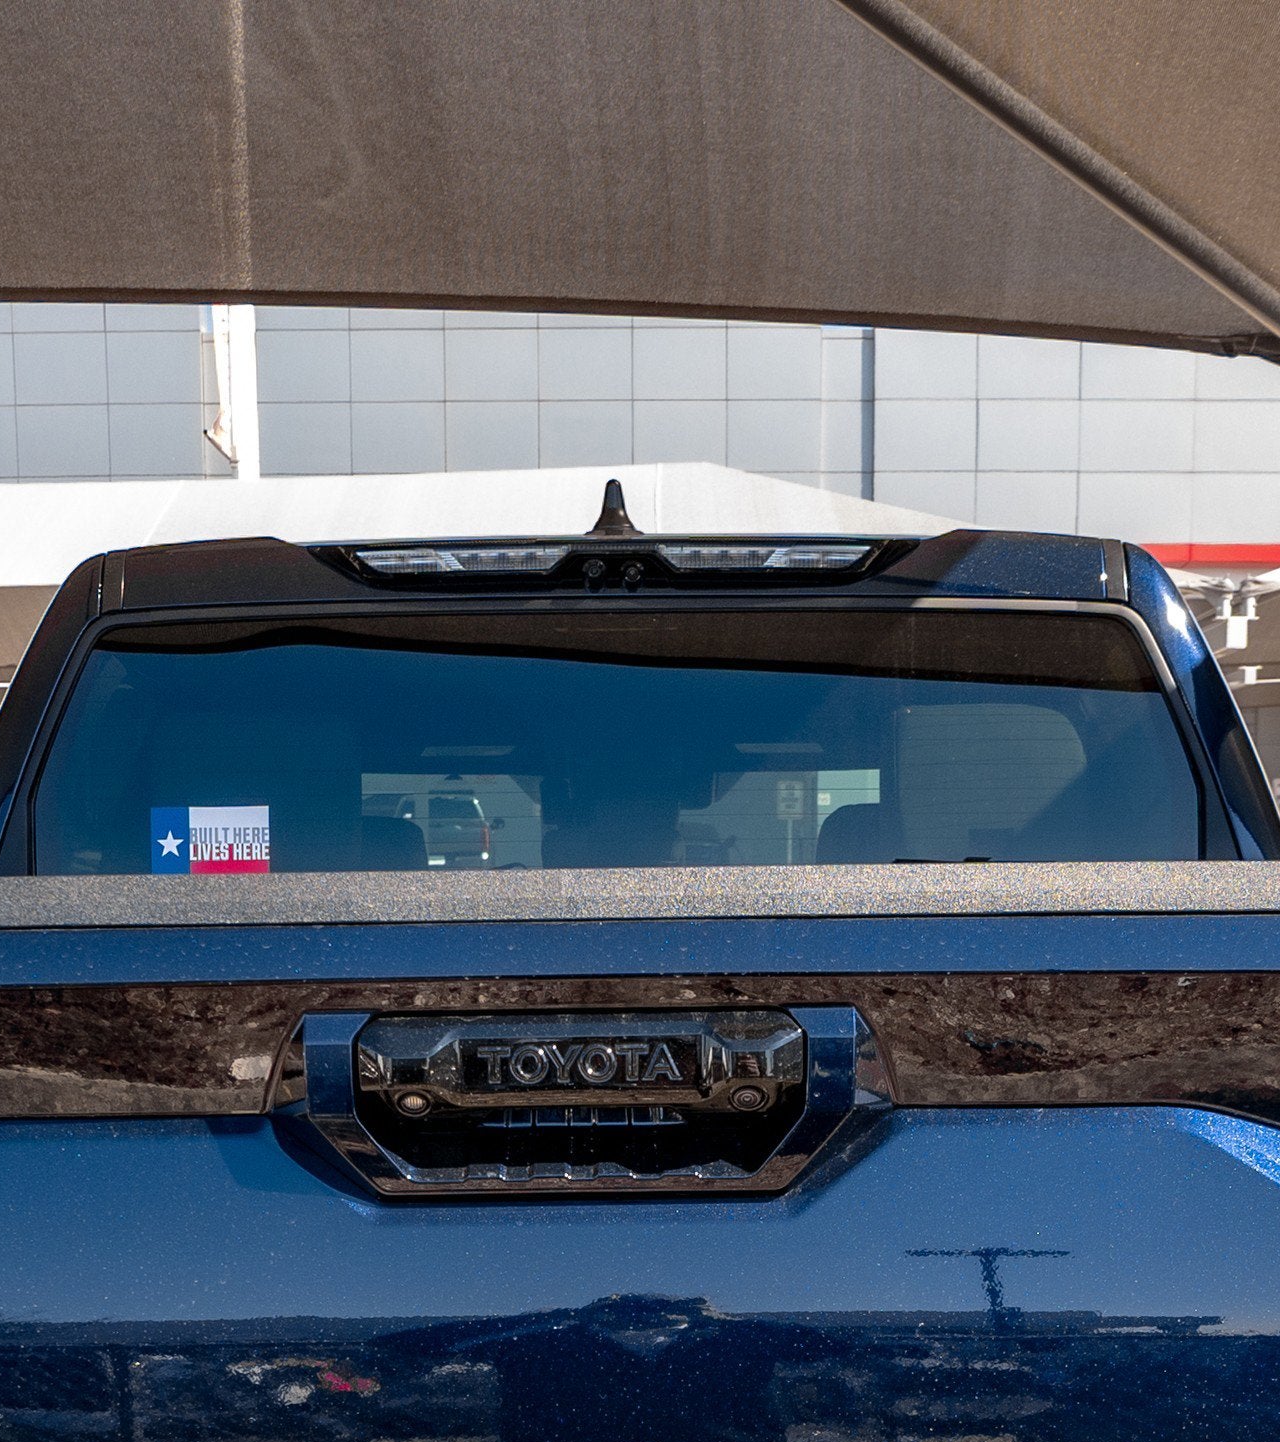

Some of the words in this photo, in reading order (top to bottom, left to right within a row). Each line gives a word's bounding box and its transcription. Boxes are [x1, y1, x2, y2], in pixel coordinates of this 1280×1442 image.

[189, 827, 230, 844] BUILT
[233, 827, 269, 843] HERE
[189, 843, 230, 861] LIVES
[233, 843, 270, 861] HERE
[477, 1042, 684, 1085] TOYOTA
